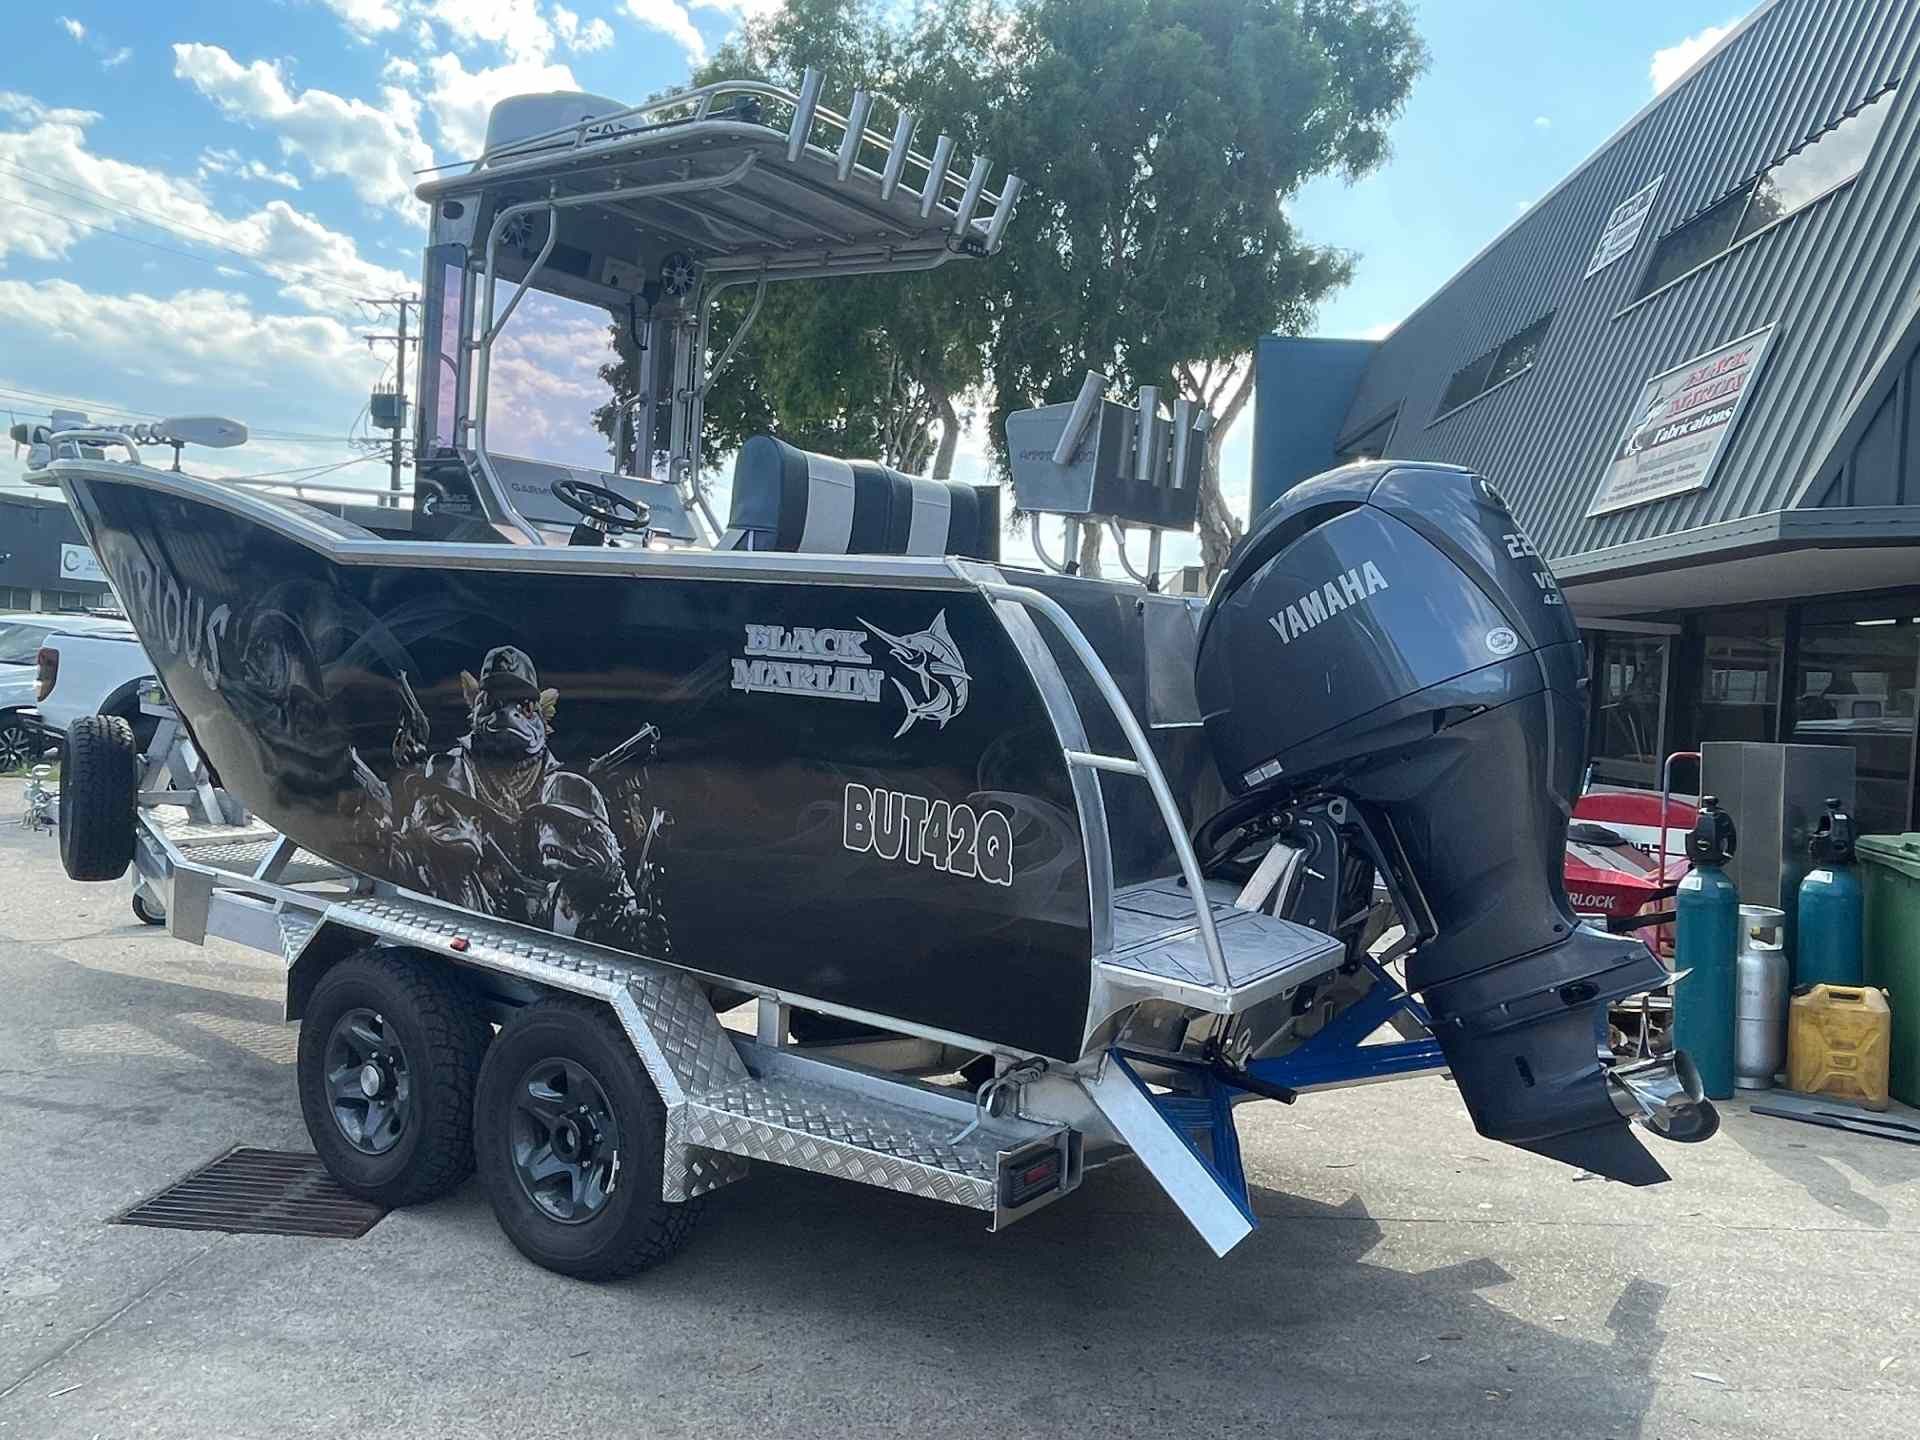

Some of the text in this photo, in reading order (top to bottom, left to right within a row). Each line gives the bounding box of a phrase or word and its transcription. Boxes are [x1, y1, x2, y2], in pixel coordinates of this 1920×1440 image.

[1651, 406, 1734, 446] Fabrications
[1502, 533, 1538, 560] 22
[1268, 559, 1390, 645] YAMAHA
[744, 623, 873, 664] BLACK
[731, 658, 885, 703] MARLIN
[843, 783, 1013, 887] BUT42Q
[1567, 891, 1617, 910] RLOCK
